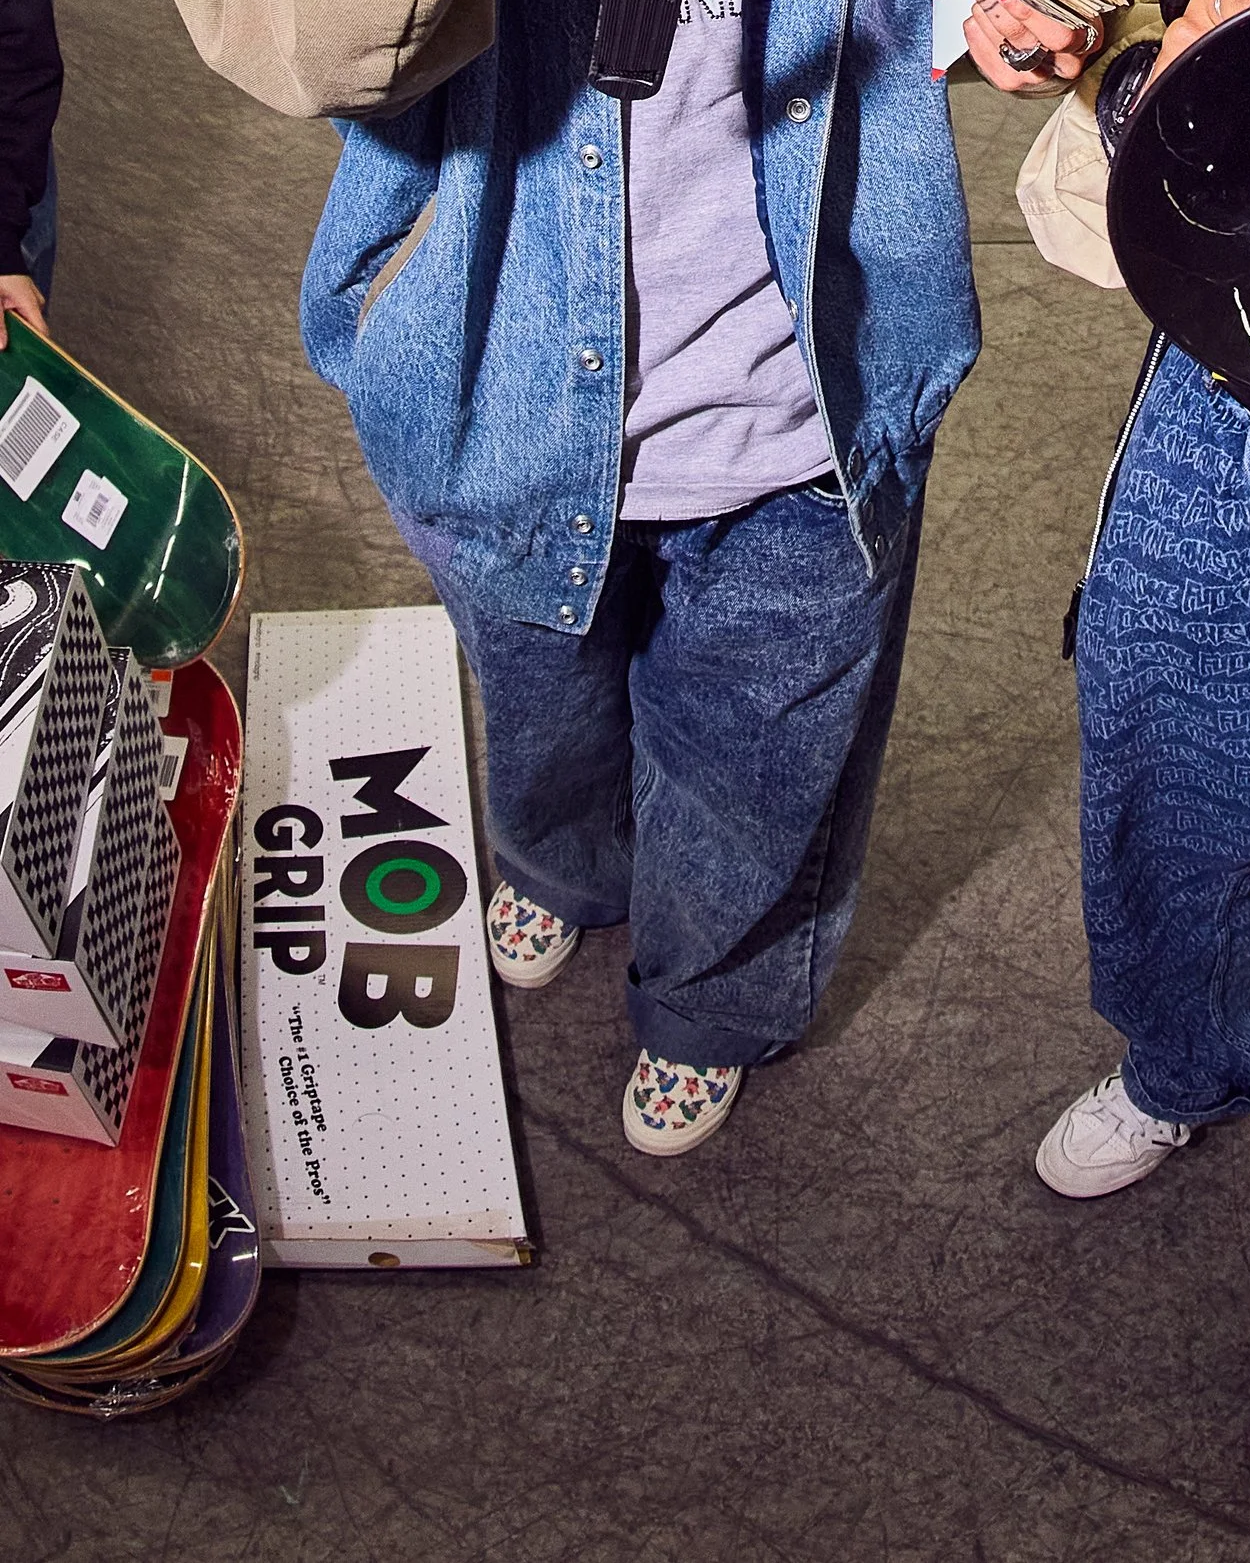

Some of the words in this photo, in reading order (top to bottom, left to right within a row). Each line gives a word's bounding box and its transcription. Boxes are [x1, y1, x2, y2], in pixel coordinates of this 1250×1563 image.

[253, 803, 327, 976] GRIP
[328, 745, 468, 1030] MOB
[278, 1055, 299, 1107] Choice
[300, 1063, 328, 1132] Griptape
[292, 1109, 308, 1127] of
[297, 1129, 313, 1157] the
